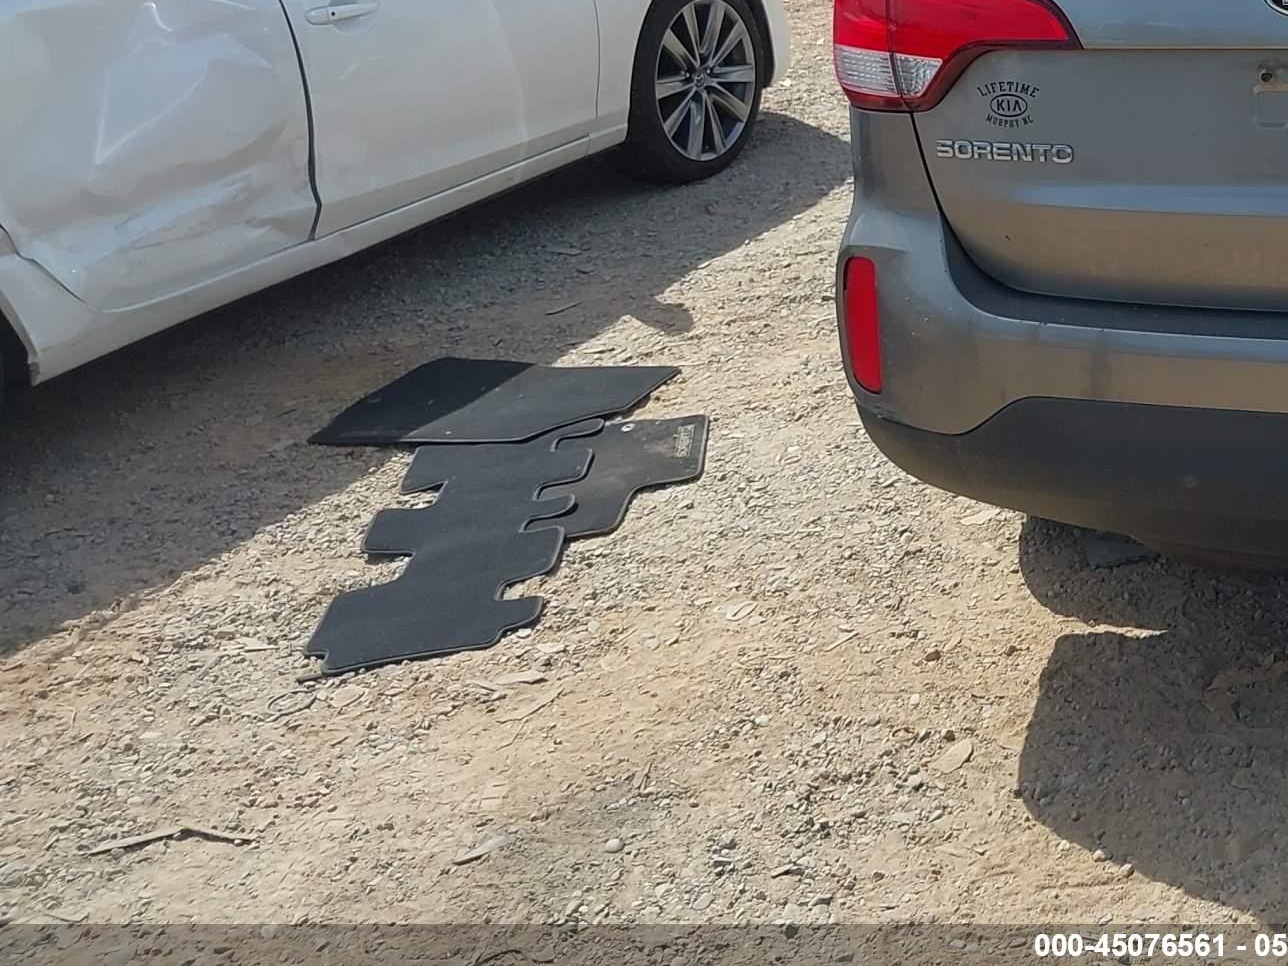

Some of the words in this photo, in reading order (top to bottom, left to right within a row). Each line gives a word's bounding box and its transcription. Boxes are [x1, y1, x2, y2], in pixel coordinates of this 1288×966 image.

[977, 81, 1040, 98] LIFETIME
[996, 98, 1023, 112] KIA
[985, 113, 1020, 129] MURPHY
[1021, 114, 1035, 126] NC
[936, 139, 1074, 164] SORENTO
